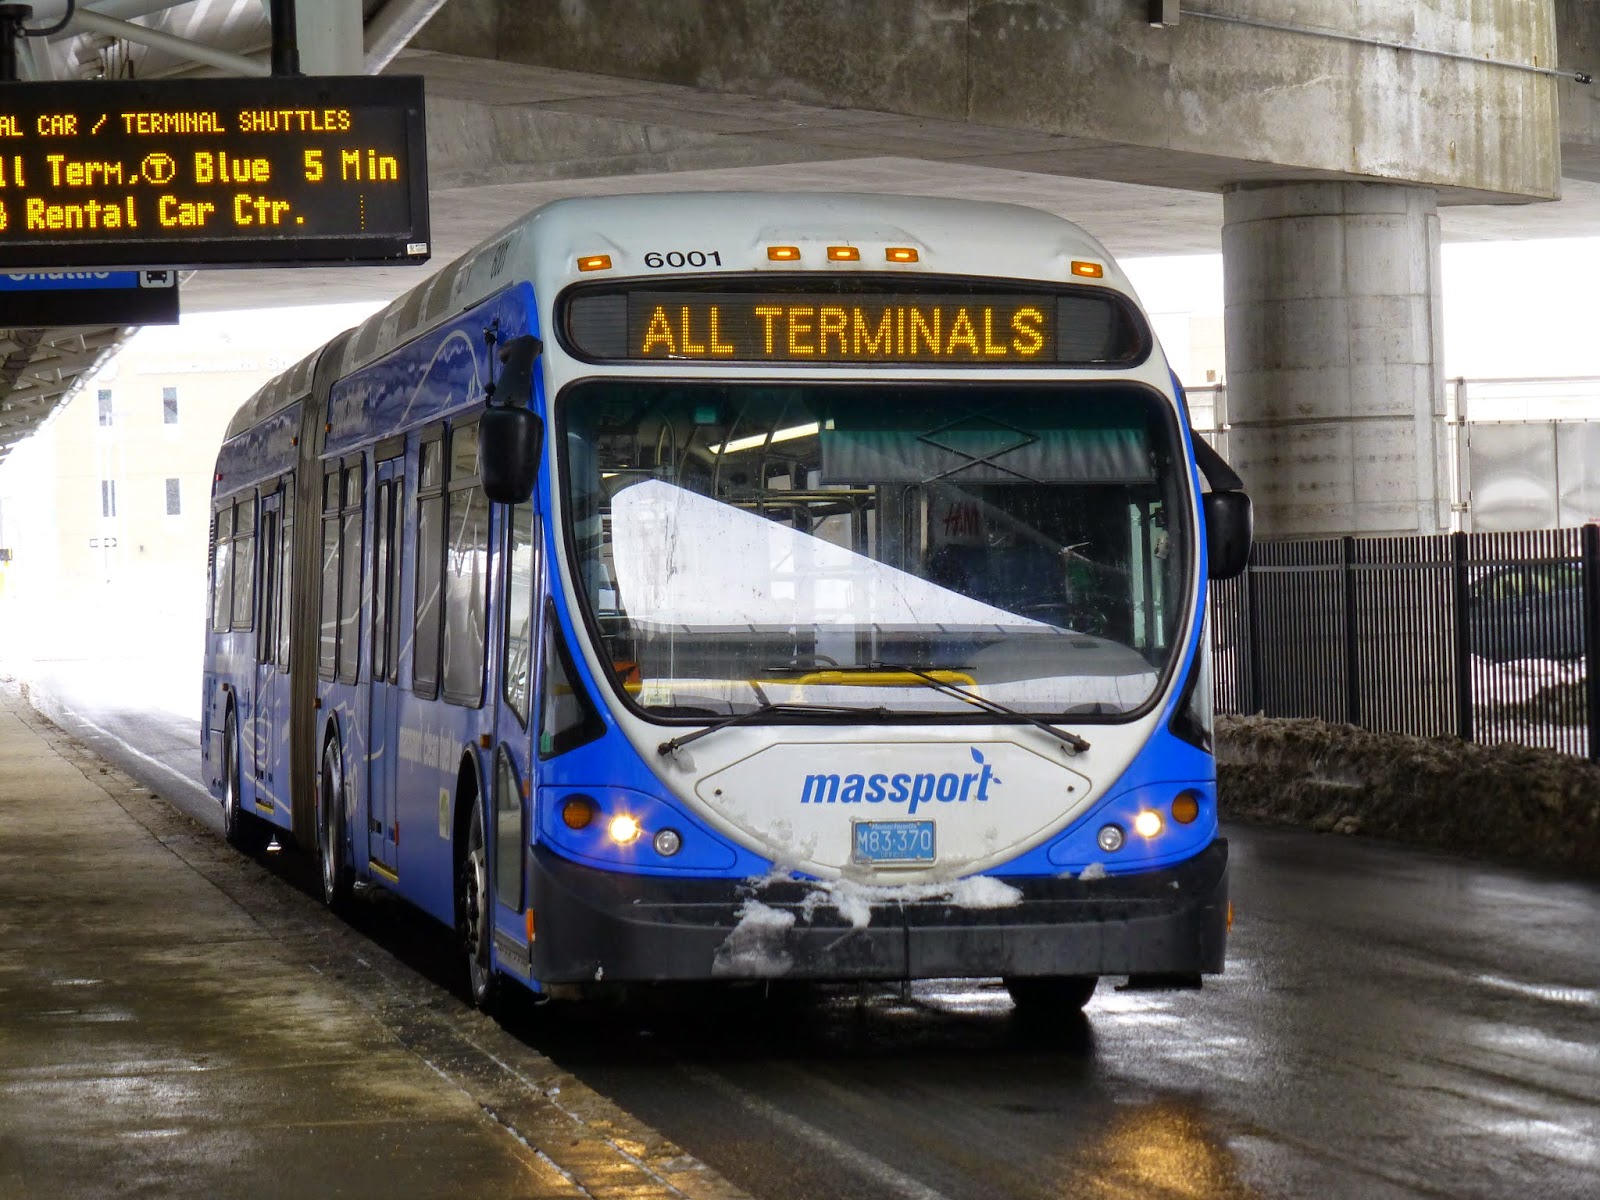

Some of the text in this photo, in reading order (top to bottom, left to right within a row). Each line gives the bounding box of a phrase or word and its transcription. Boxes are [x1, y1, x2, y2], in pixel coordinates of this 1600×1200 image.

[38, 114, 77, 136] CAR
[92, 113, 106, 134] /
[121, 112, 225, 134] TERMINAL
[239, 109, 351, 132] SHUTTLES
[194, 152, 271, 184] Blue
[304, 150, 325, 182] 5
[341, 148, 399, 182] Min
[26, 196, 137, 230] Rental
[158, 195, 215, 228] Car
[233, 192, 305, 226] Ctr.
[645, 251, 721, 269] 6001
[642, 306, 1046, 356] ALL TERMINALS
[801, 762, 993, 814] massport
